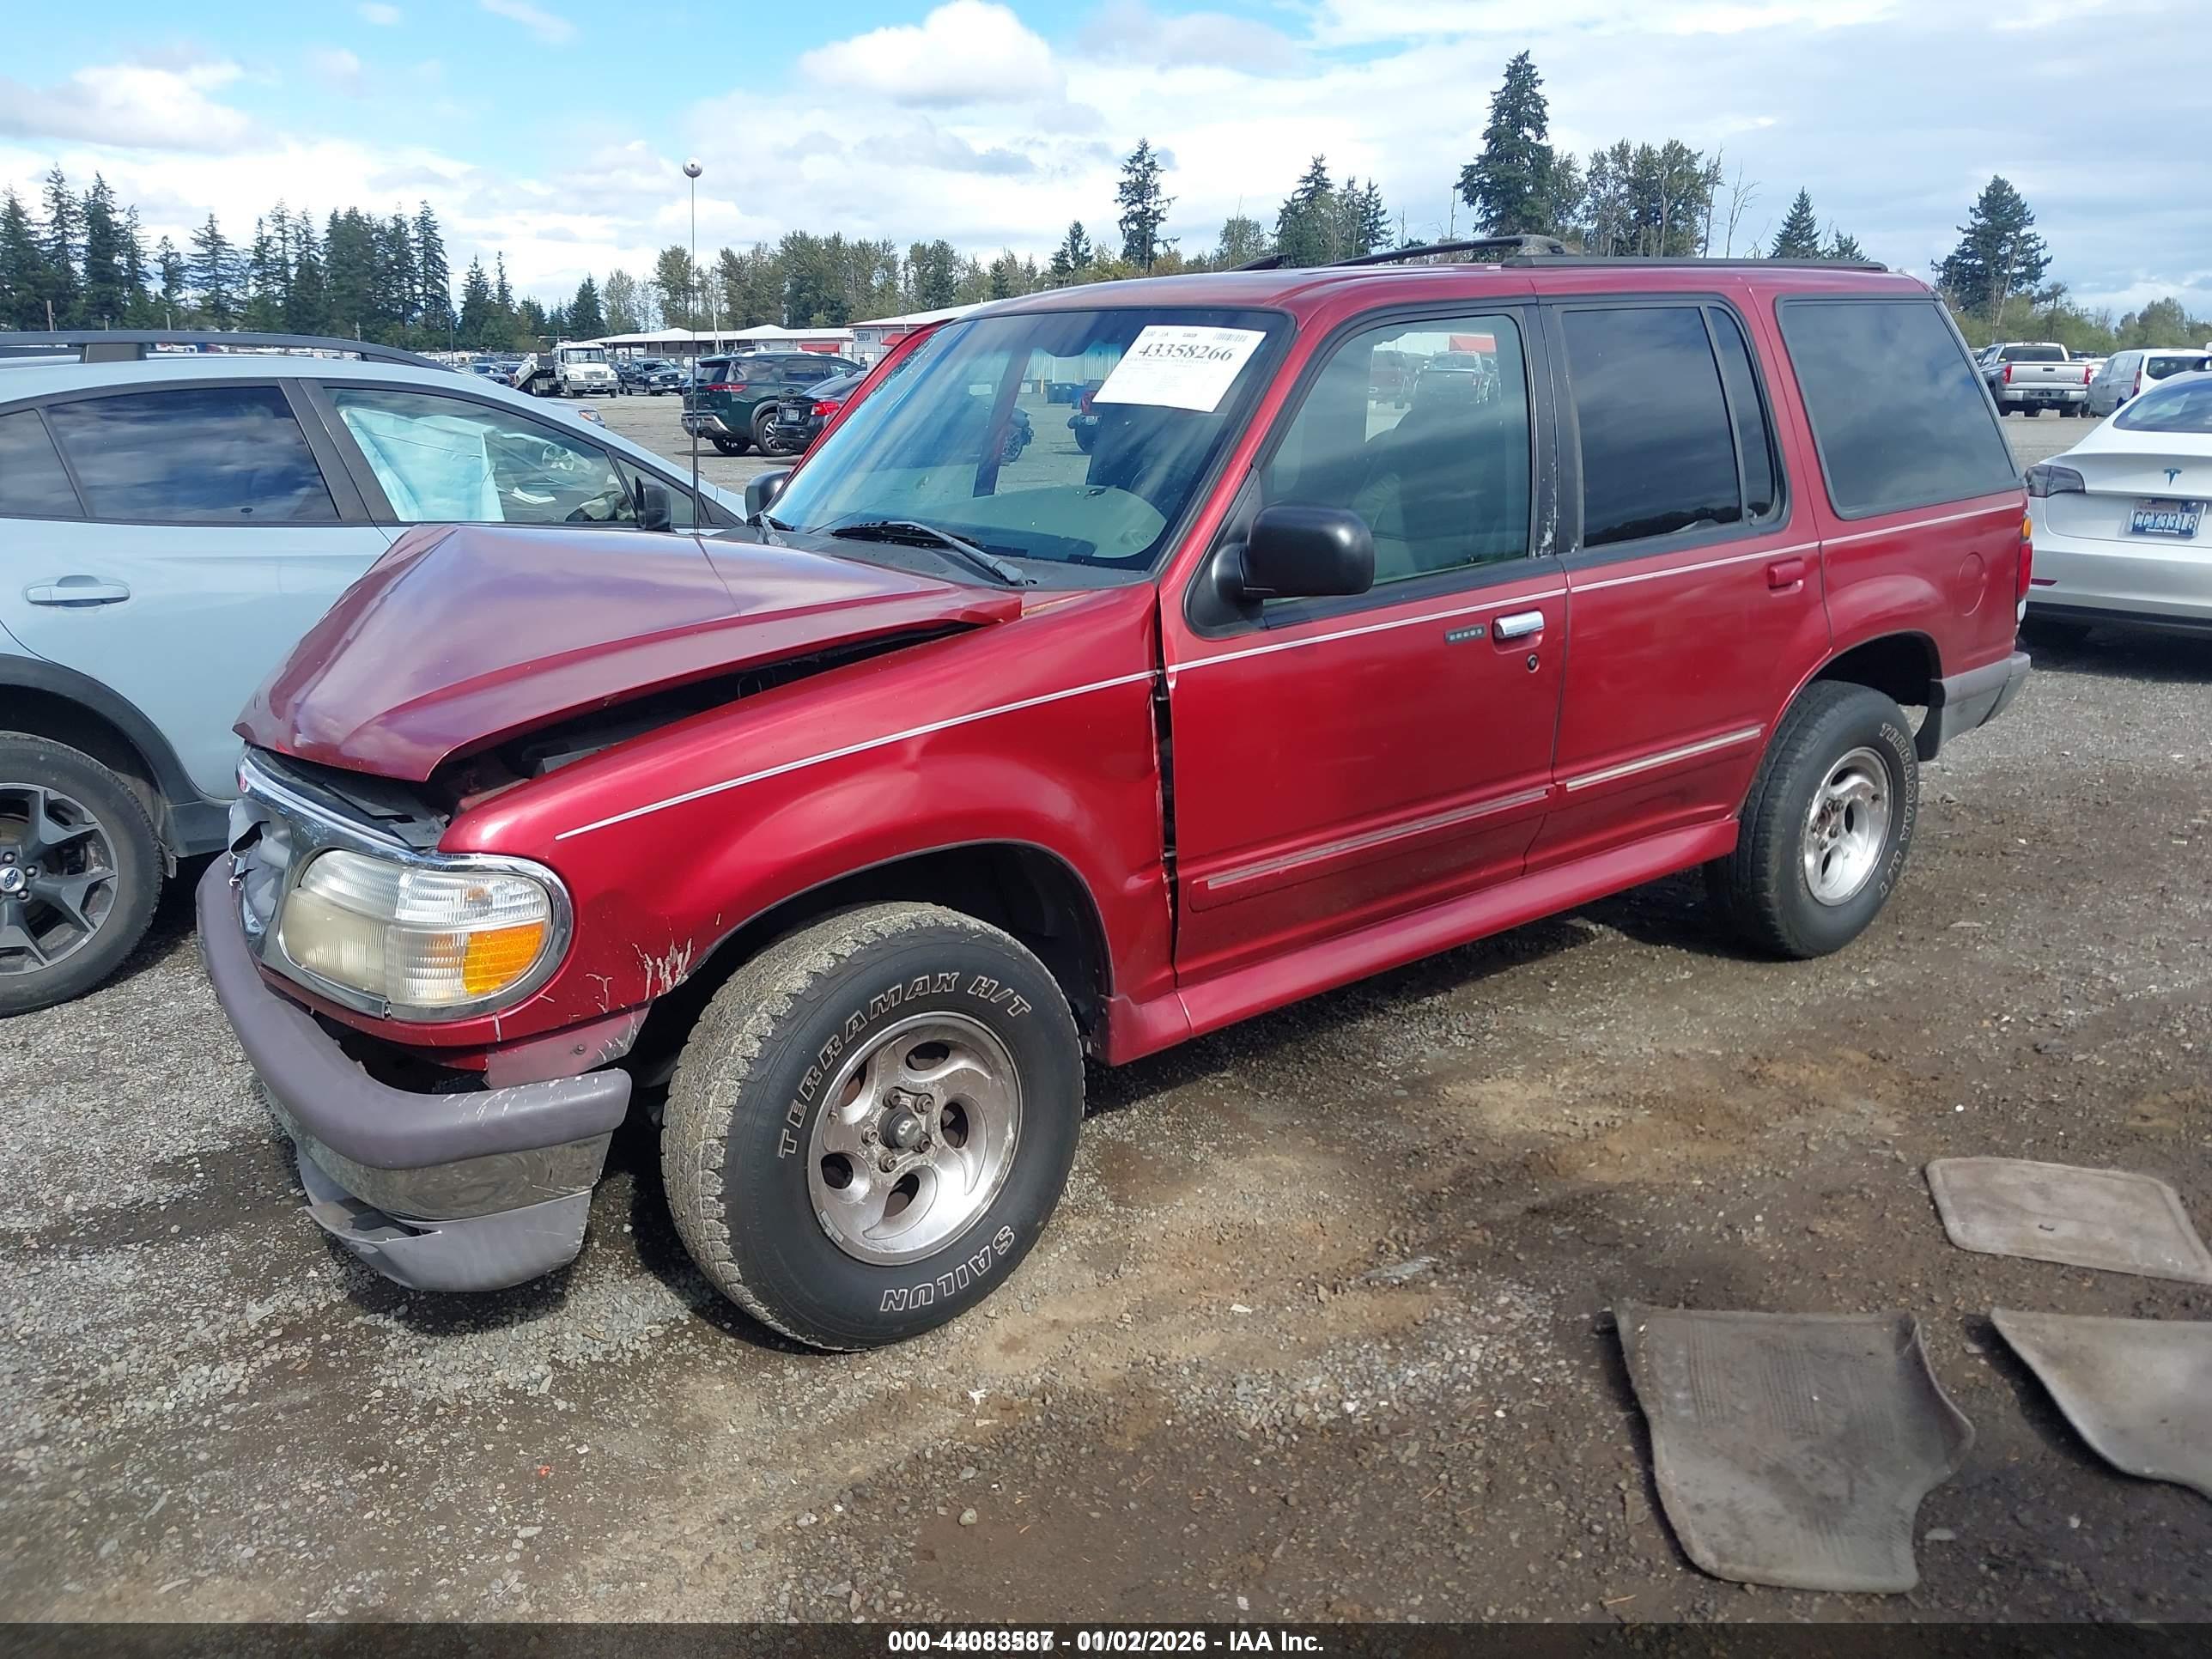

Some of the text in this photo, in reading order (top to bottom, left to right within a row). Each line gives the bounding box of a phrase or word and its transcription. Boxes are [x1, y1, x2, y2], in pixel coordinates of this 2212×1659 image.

[1138, 343, 1237, 362] 43358266
[777, 971, 1032, 1160] TERRAMAX H/T
[879, 1224, 1016, 1312] SAILUN
